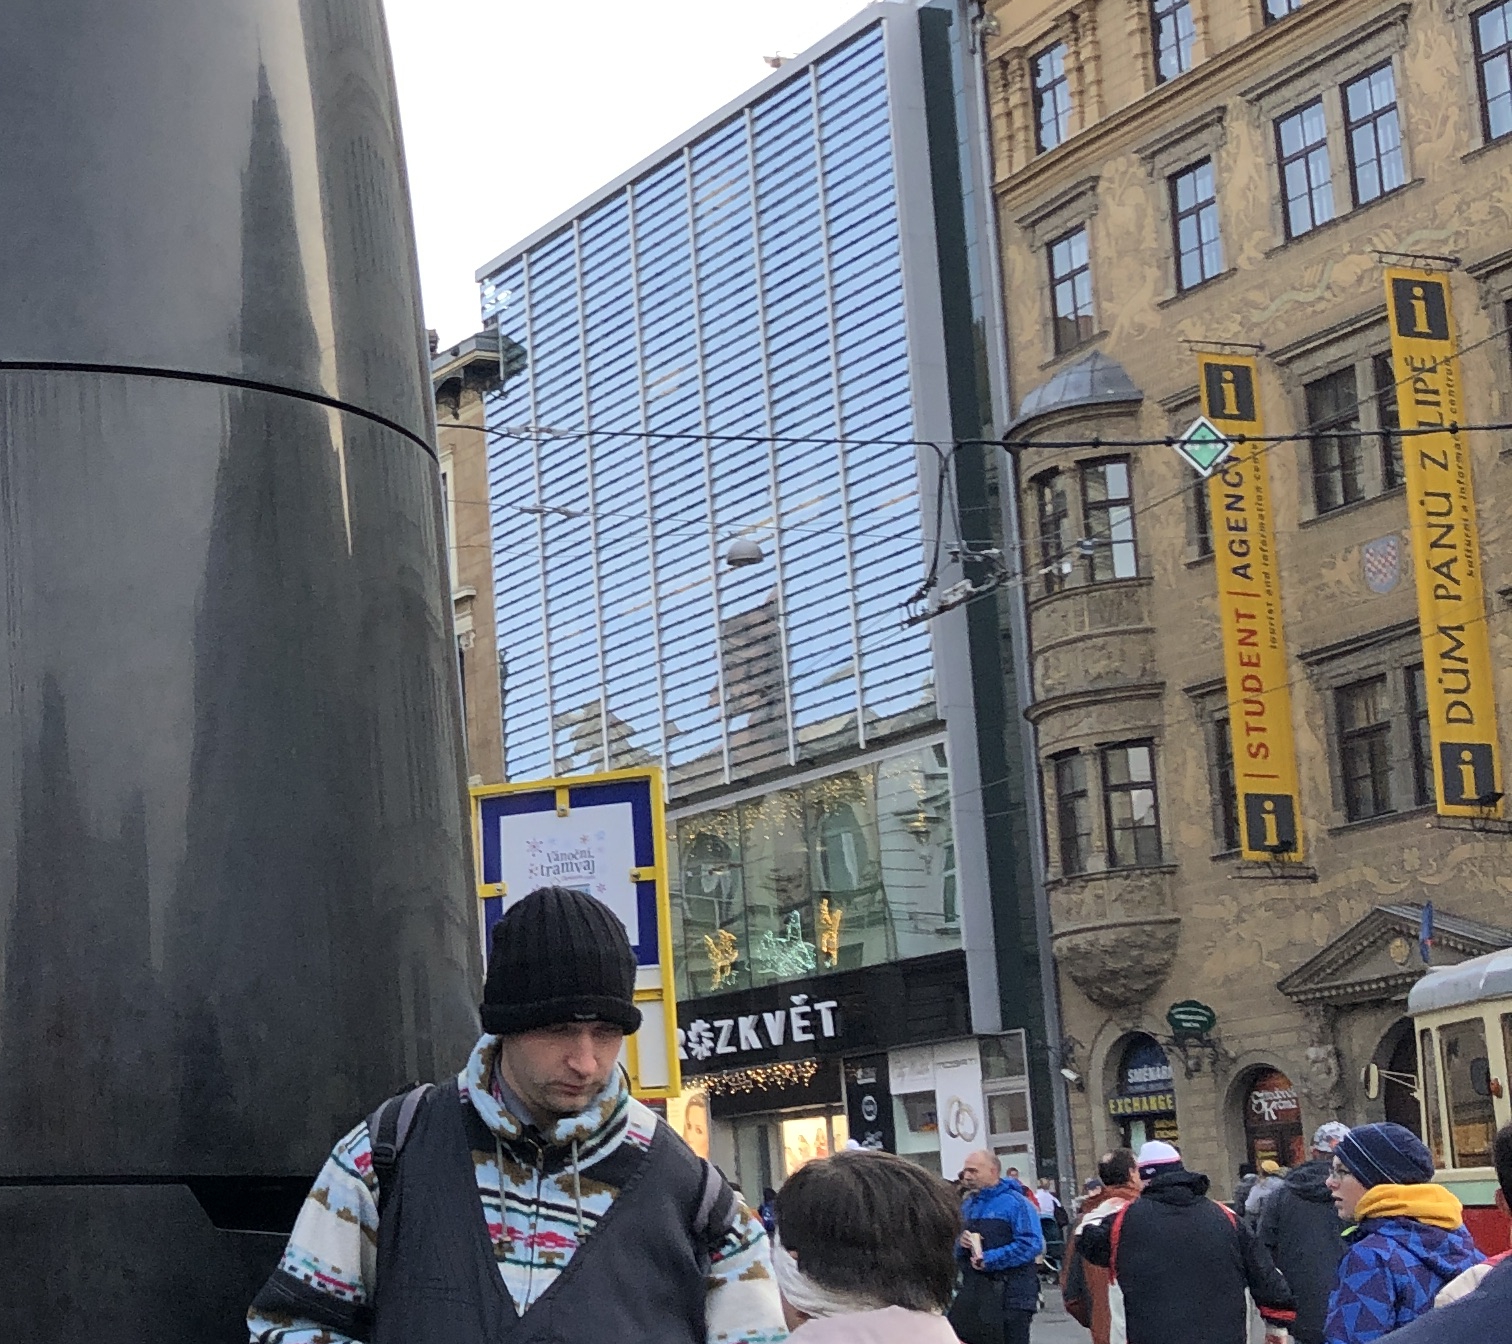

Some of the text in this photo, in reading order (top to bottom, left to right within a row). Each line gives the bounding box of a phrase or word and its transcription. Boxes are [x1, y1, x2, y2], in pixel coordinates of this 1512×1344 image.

[1419, 449, 1449, 472] Z
[1234, 608, 1271, 761] STUDENT
[1437, 623, 1475, 726] DŮM
[540, 859, 596, 877] tramvaj
[1108, 1094, 1175, 1115] EXCHANGE
